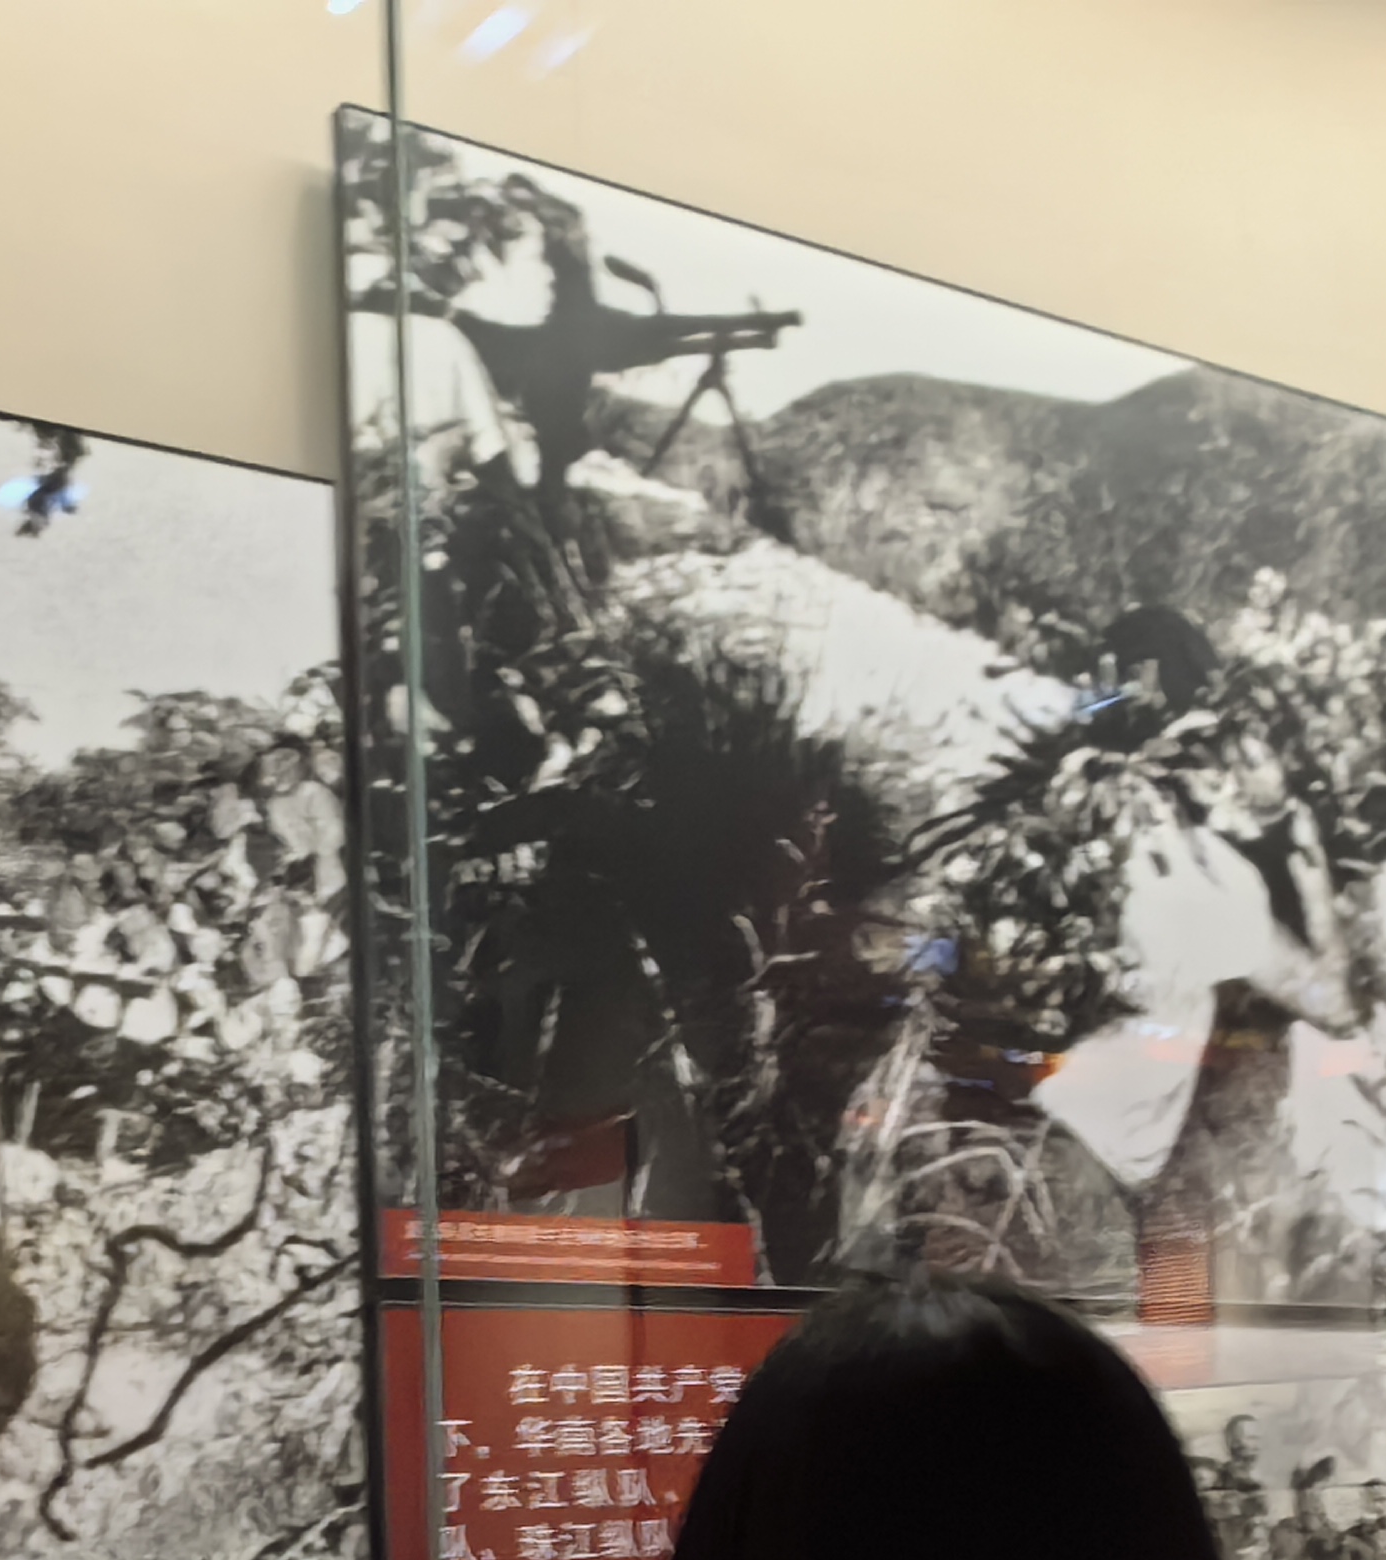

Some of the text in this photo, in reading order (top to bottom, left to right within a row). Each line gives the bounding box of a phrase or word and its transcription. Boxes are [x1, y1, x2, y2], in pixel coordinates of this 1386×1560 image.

[508, 1364, 747, 1404] 在中国共产党
[435, 1415, 728, 1458] 下，华南各地先
